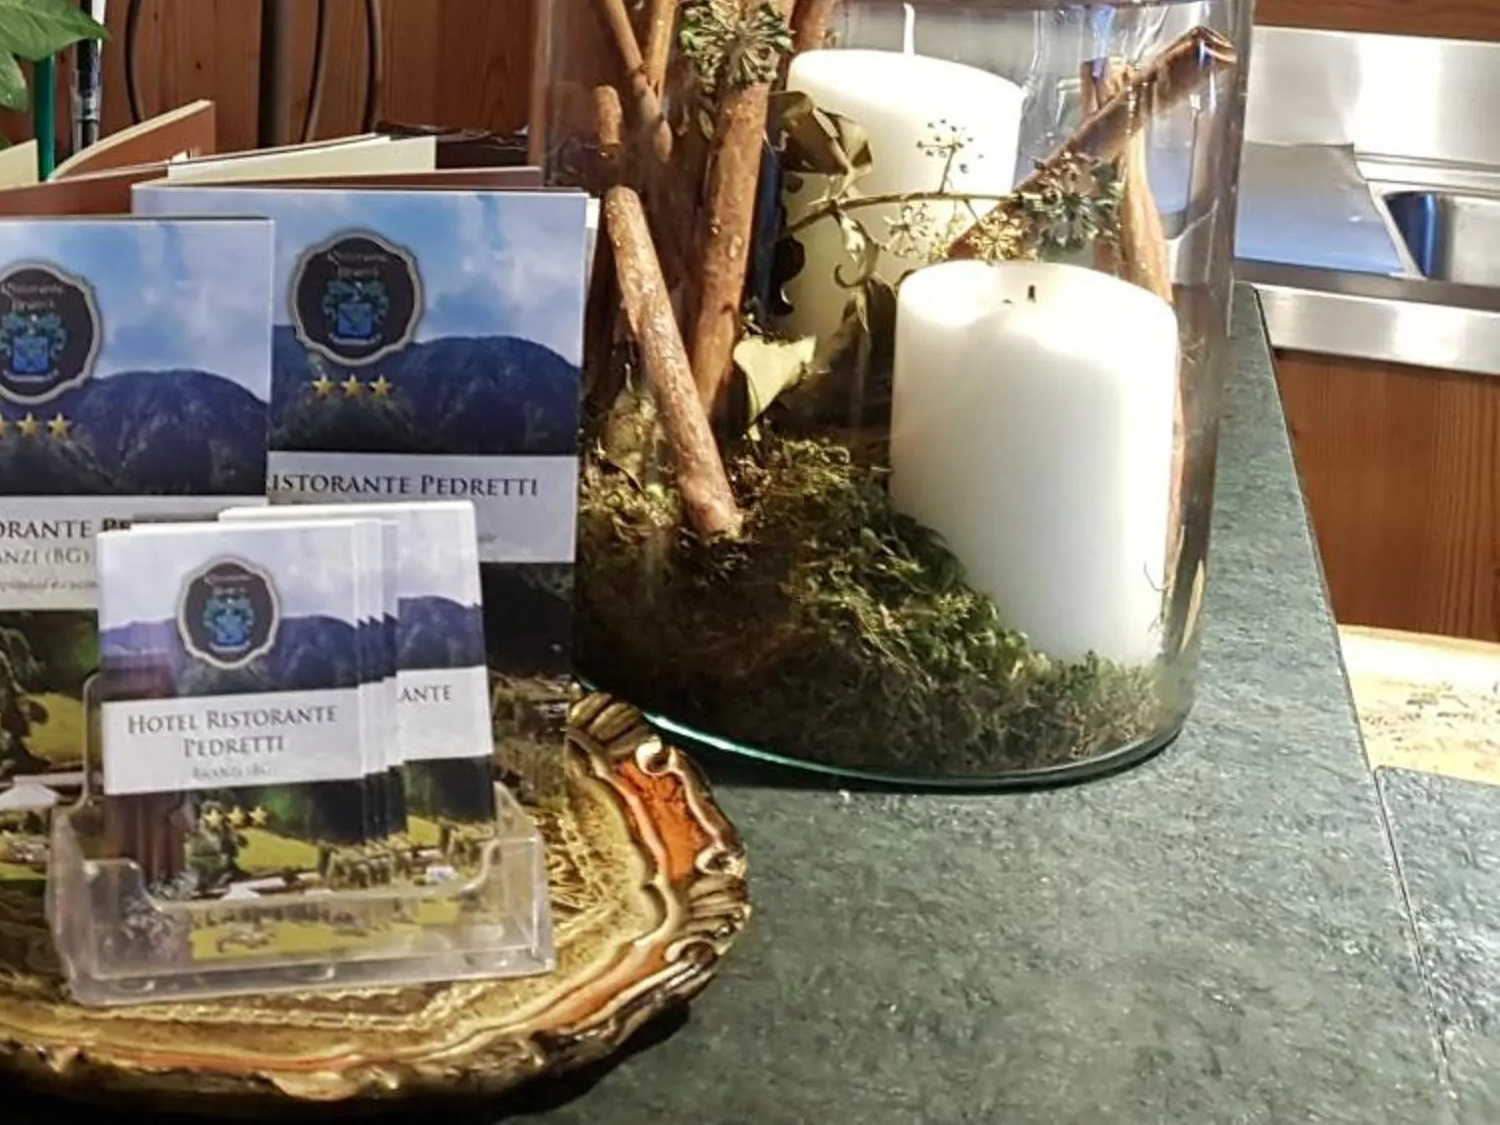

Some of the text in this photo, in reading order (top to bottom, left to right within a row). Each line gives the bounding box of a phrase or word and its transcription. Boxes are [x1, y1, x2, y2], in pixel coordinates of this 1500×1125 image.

[267, 474, 538, 498] ISTORANTE PEDRETTI
[44, 547, 91, 566] (BG)
[127, 705, 338, 735] HOTEL RISTORANTE
[183, 735, 284, 758] PEDRETTI
